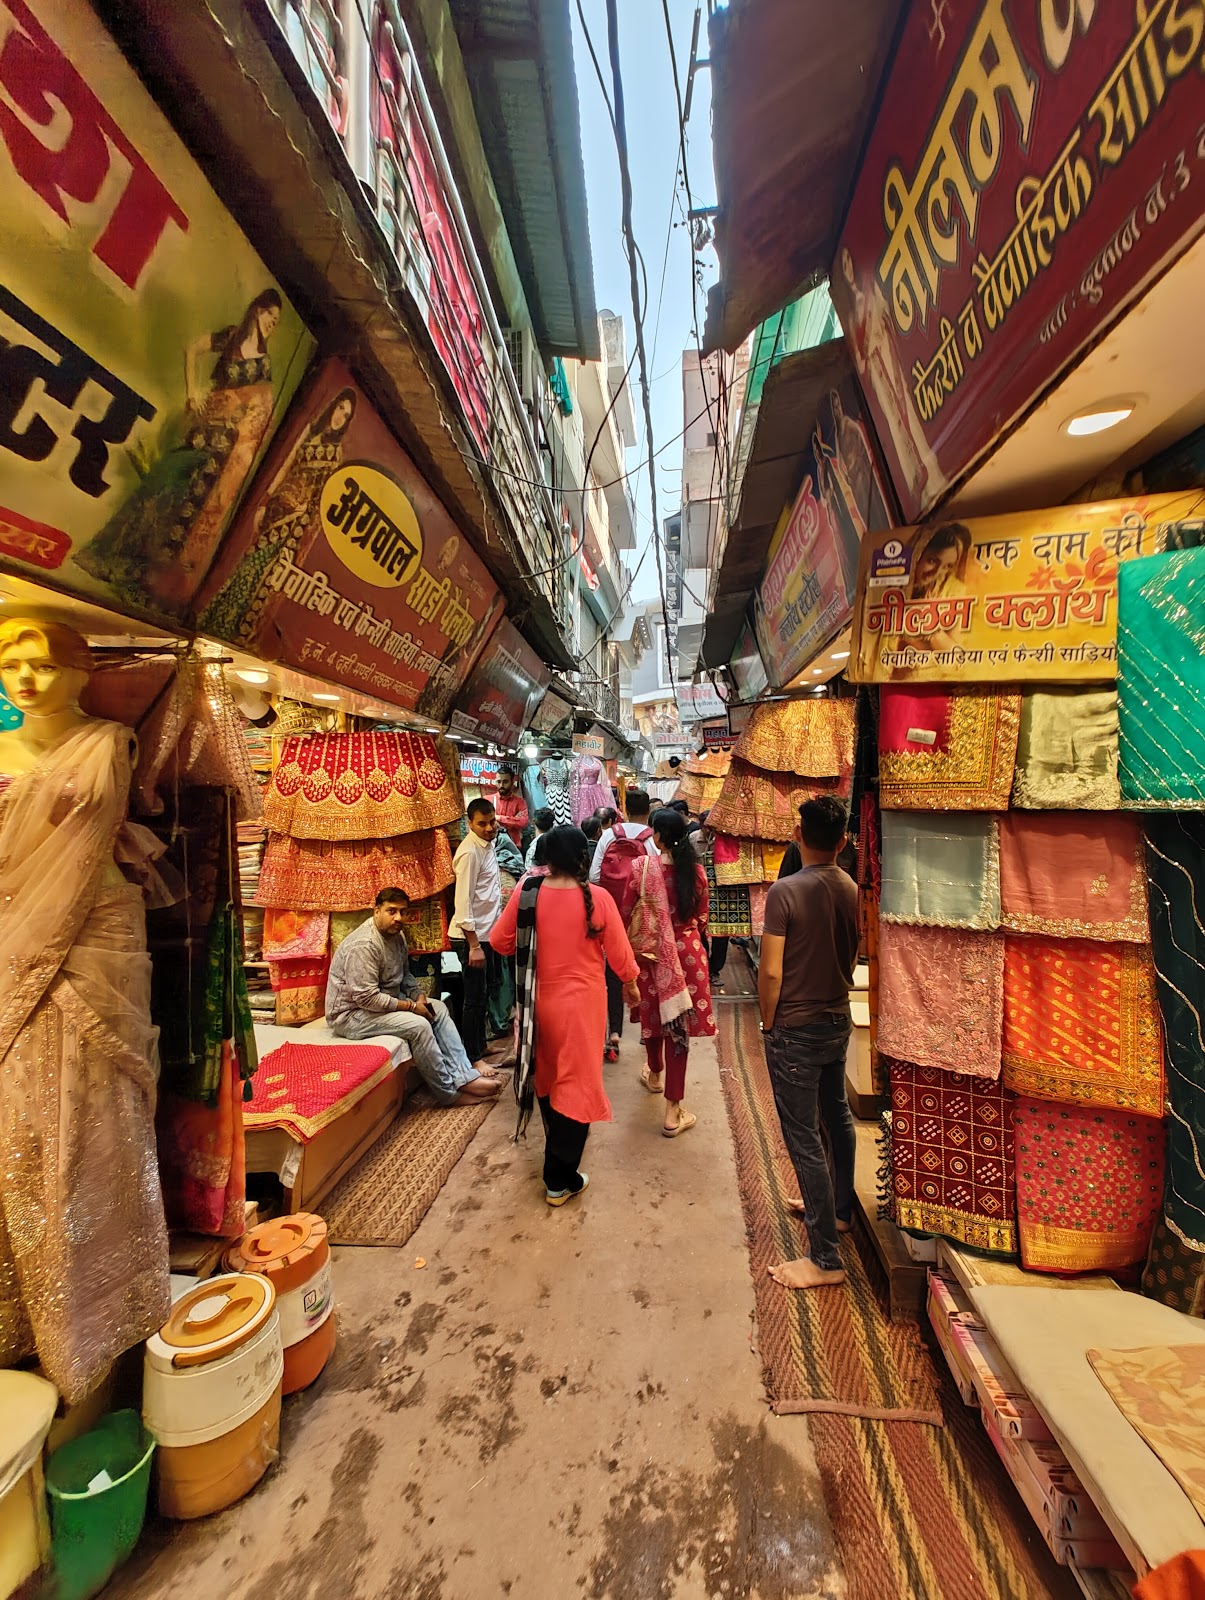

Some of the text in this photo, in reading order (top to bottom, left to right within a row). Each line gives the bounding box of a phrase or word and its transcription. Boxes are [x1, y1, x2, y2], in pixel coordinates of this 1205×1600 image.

[957, 301, 984, 358] व
[972, 128, 1093, 331] वैवाहिक
[326, 477, 419, 582] अग्रवाल
[762, 475, 819, 616] अग्रवाल
[974, 538, 1021, 571] एक
[1033, 530, 1090, 566] दाम
[1103, 511, 1149, 560] की
[333, 600, 364, 632] एवं
[405, 567, 452, 626] साड़ी
[866, 577, 1116, 635] नीलम क्लॉथ
[881, 646, 929, 668] वैवाहिक
[934, 645, 983, 665] साड़िया
[988, 643, 1008, 664] एवं
[575, 739, 601, 750] महावीर
